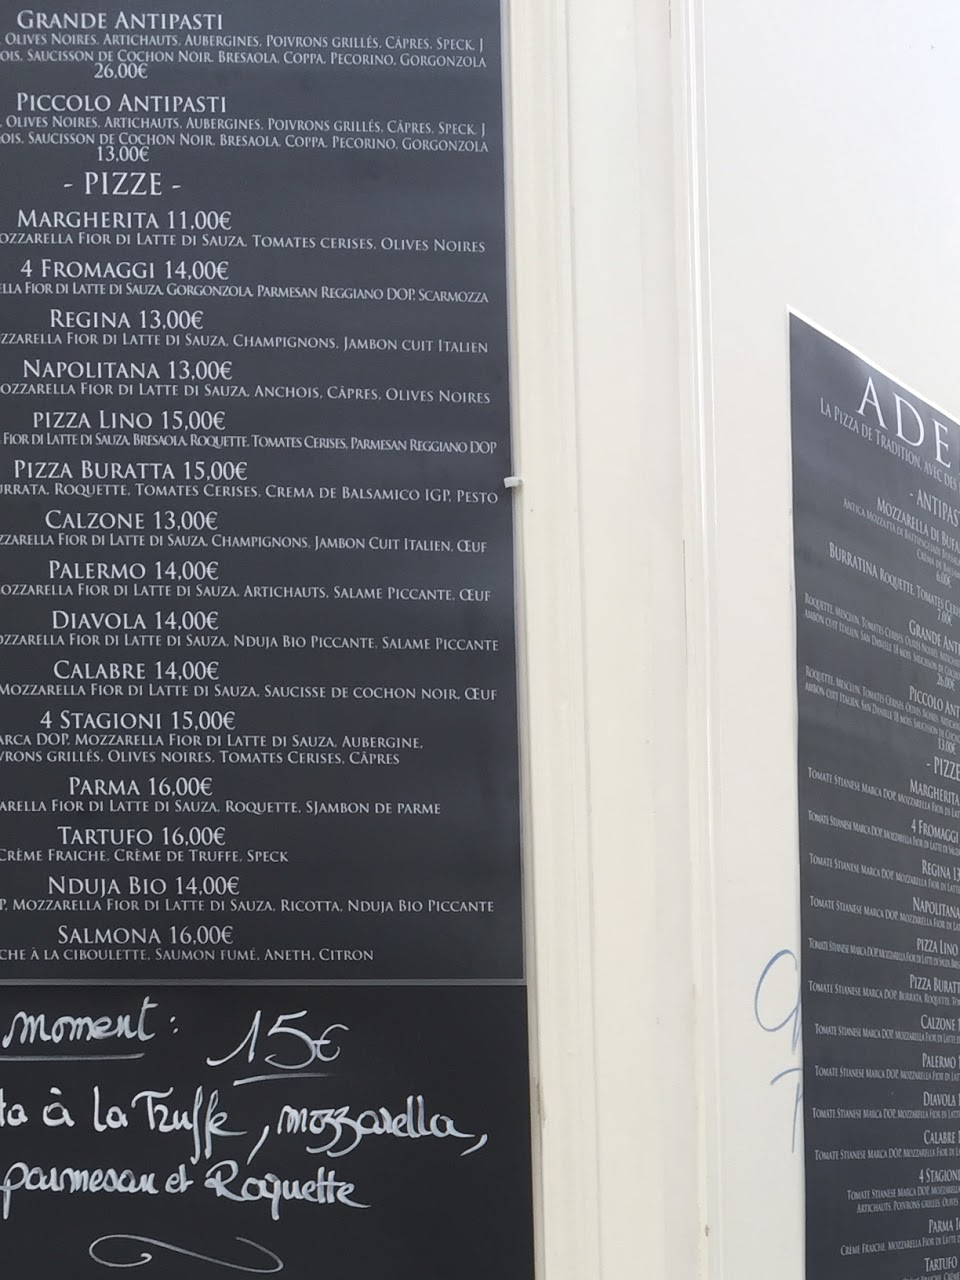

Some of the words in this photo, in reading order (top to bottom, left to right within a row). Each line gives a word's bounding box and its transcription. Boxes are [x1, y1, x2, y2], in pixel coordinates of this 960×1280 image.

[17, 10, 106, 29] GRANDE
[115, 11, 222, 30] ANTIPASTI
[5, 33, 47, 45] OLIVES
[267, 35, 327, 47] POIVRONS
[28, 49, 93, 61] SAUCISSON
[99, 51, 113, 61] DE
[118, 50, 173, 62] COCHON
[400, 54, 486, 67] GORGONZOLA
[94, 63, 148, 78] 26,00€
[18, 93, 111, 111] PICCOLO
[118, 94, 225, 112] ANTIPASTI
[98, 146, 149, 162] 13,00€
[85, 172, 162, 195] PIZZE
[18, 209, 159, 228] MARGHERITA
[168, 211, 231, 230] 11,00€
[21, 260, 32, 277] 4
[42, 259, 154, 278] FROMAGGI
[166, 261, 228, 280] 14,00€
[51, 309, 131, 328] REGINA
[140, 310, 203, 329] 13,00€
[24, 360, 160, 378] NAPOLITANA
[169, 360, 232, 380] 13,00€
[34, 412, 91, 428] PIZZA
[100, 410, 152, 429] LINO
[162, 411, 225, 431] 15,00€
[820, 397, 831, 418] LA
[834, 405, 859, 433] PIZZA
[861, 423, 872, 441] DE
[924, 461, 942, 482] AVEC
[944, 473, 957, 491] DES
[15, 460, 73, 478] PIZZA
[82, 460, 175, 479] BURATTA
[184, 461, 247, 480] 15,00€
[45, 510, 144, 529] CALZONE
[154, 511, 217, 530] 13,00€
[877, 497, 929, 537] MOZZARELLA
[930, 526, 939, 542] DI
[49, 560, 145, 579] PALERMO
[155, 561, 218, 580] 14,00€
[829, 541, 878, 579] BURRATINA
[53, 610, 146, 629] DIAVOLA
[156, 611, 218, 630] 14,00€
[908, 619, 941, 647] GRANDE
[54, 660, 145, 679] CALABRE
[155, 661, 219, 680] 14,00€
[909, 685, 943, 712] PICCOLO
[40, 711, 52, 728] 4
[61, 710, 161, 729] STAGIONI
[172, 711, 235, 730] 15,00€
[934, 756, 960, 781] PIZZE
[70, 777, 140, 795] PARMA
[149, 777, 212, 796] 16,00€
[909, 779, 960, 808] MARGHERITA
[57, 826, 152, 845] TARTUFO
[162, 827, 225, 846] 16,00€
[918, 819, 959, 844] FROMAGGI
[167, 851, 183, 861] DE
[247, 850, 288, 862] SPECK
[921, 859, 951, 880] REGINA
[49, 876, 120, 898] NDUJA
[129, 876, 166, 894] BIO
[176, 876, 239, 895] 14,00€
[912, 896, 960, 920] NAPOLITANA
[58, 925, 161, 944] SALMONA
[170, 926, 233, 945] 16,00€
[940, 939, 958, 956] LINO
[909, 974, 931, 991] PIZZA
[920, 1013, 956, 1031] CALZONE
[207, 1010, 349, 1069] 15€
[922, 1052, 957, 1069] PALERMO
[43, 1087, 75, 1127] à
[93, 1086, 128, 1131] la
[923, 1091, 956, 1107] DIAVOLA
[923, 1129, 956, 1145] CALABRE
[165, 1164, 193, 1193] et
[926, 1168, 960, 1183] STAGIONI
[928, 1218, 954, 1234] PARMA
[924, 1256, 957, 1272] TARTUFO
